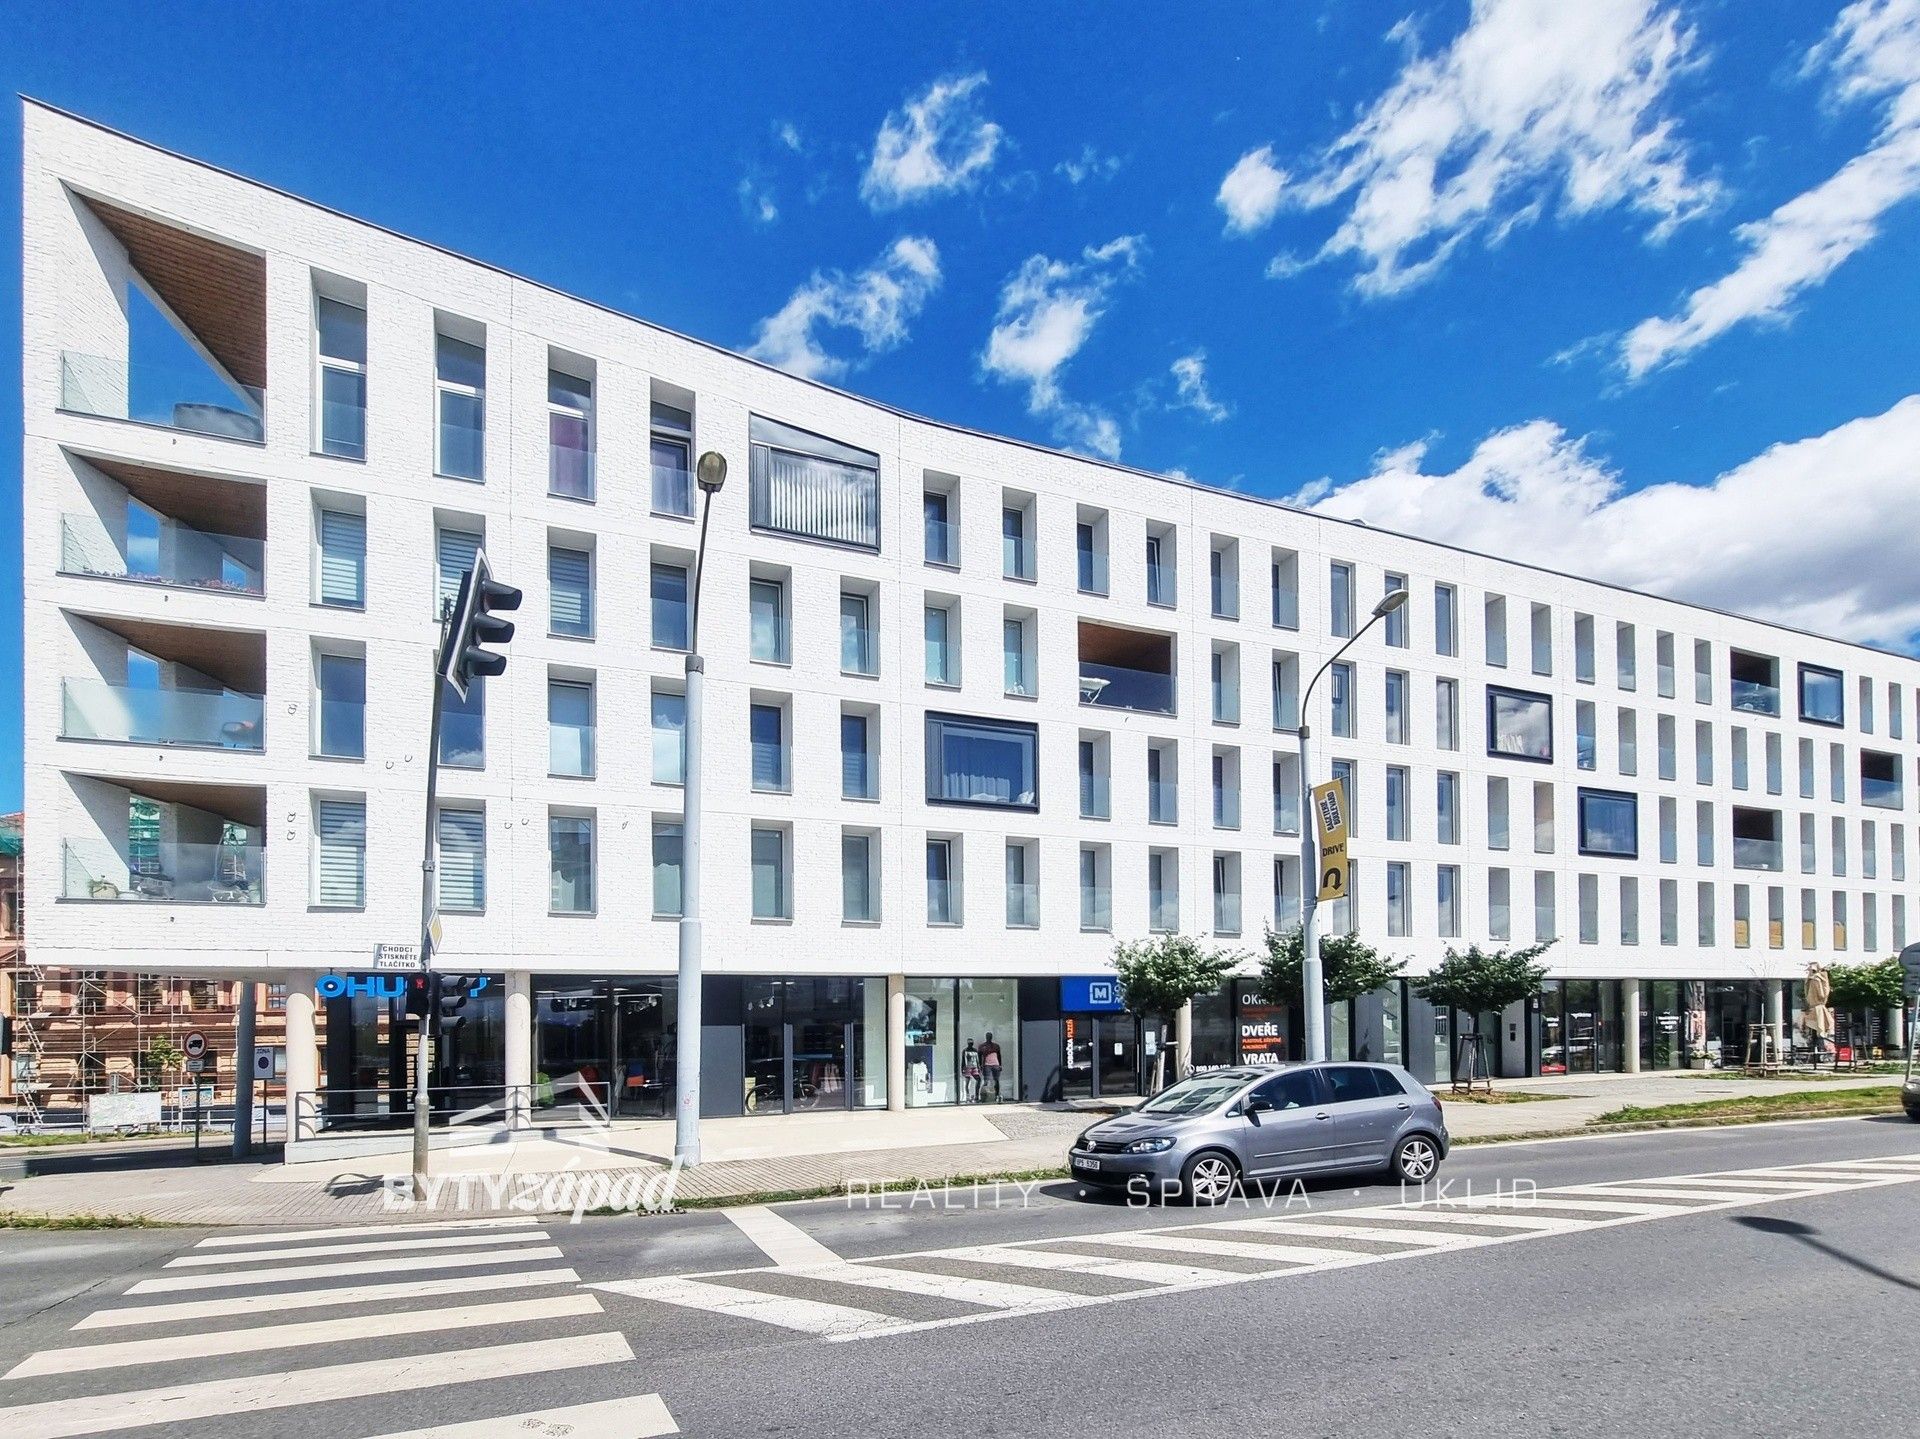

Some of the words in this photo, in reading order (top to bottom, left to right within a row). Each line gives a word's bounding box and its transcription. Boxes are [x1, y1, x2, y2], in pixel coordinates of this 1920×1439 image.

[1322, 842, 1344, 857] DRIVE
[382, 945, 413, 953] CHODCI
[378, 953, 418, 961] STISKNĚTE
[379, 960, 416, 968] TLAČÍTKO
[1241, 1022, 1278, 1037] DVEŘE
[1242, 1053, 1279, 1065] VRATA
